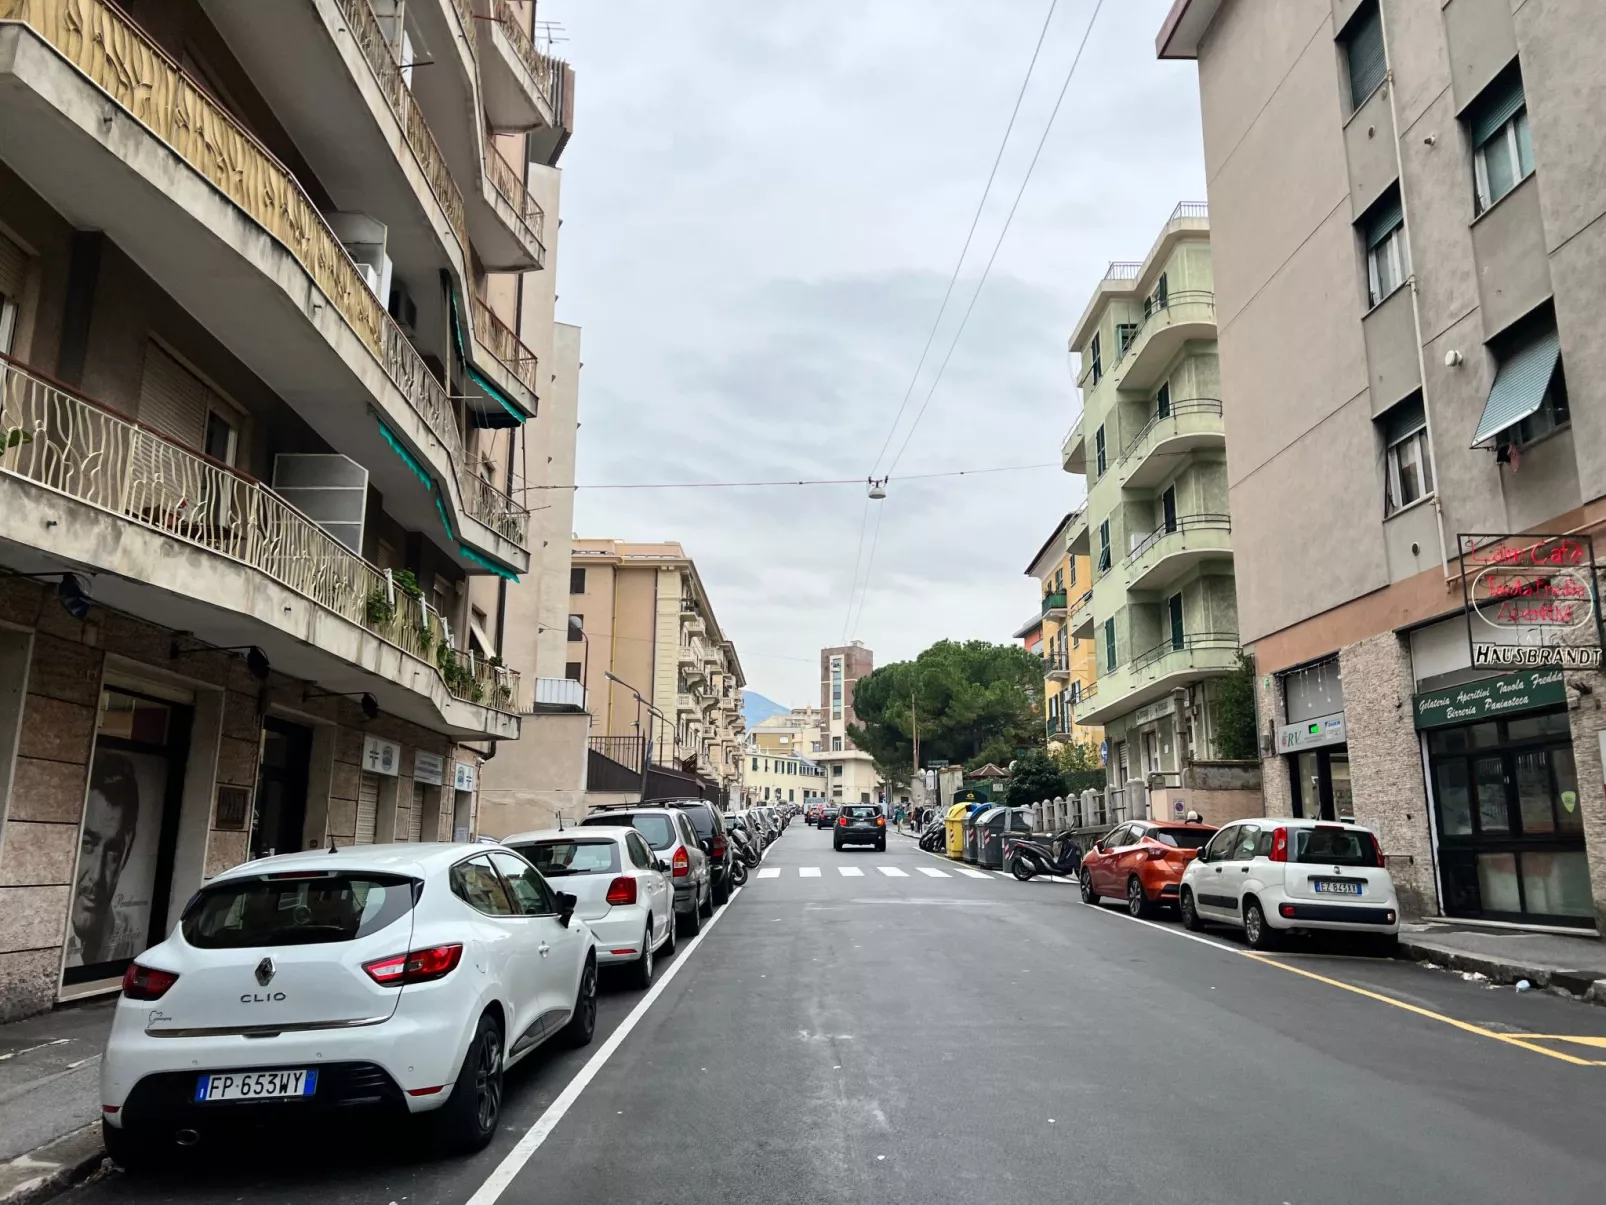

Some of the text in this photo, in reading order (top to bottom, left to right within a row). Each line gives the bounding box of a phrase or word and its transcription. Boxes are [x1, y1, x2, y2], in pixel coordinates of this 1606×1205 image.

[1476, 645, 1602, 665] HAUSBRANDT
[1419, 671, 1563, 714] Gelateria Aperitivi Tavola Fredda
[1446, 696, 1529, 719] Birreria Paninoteca
[241, 992, 286, 1003] CLIO
